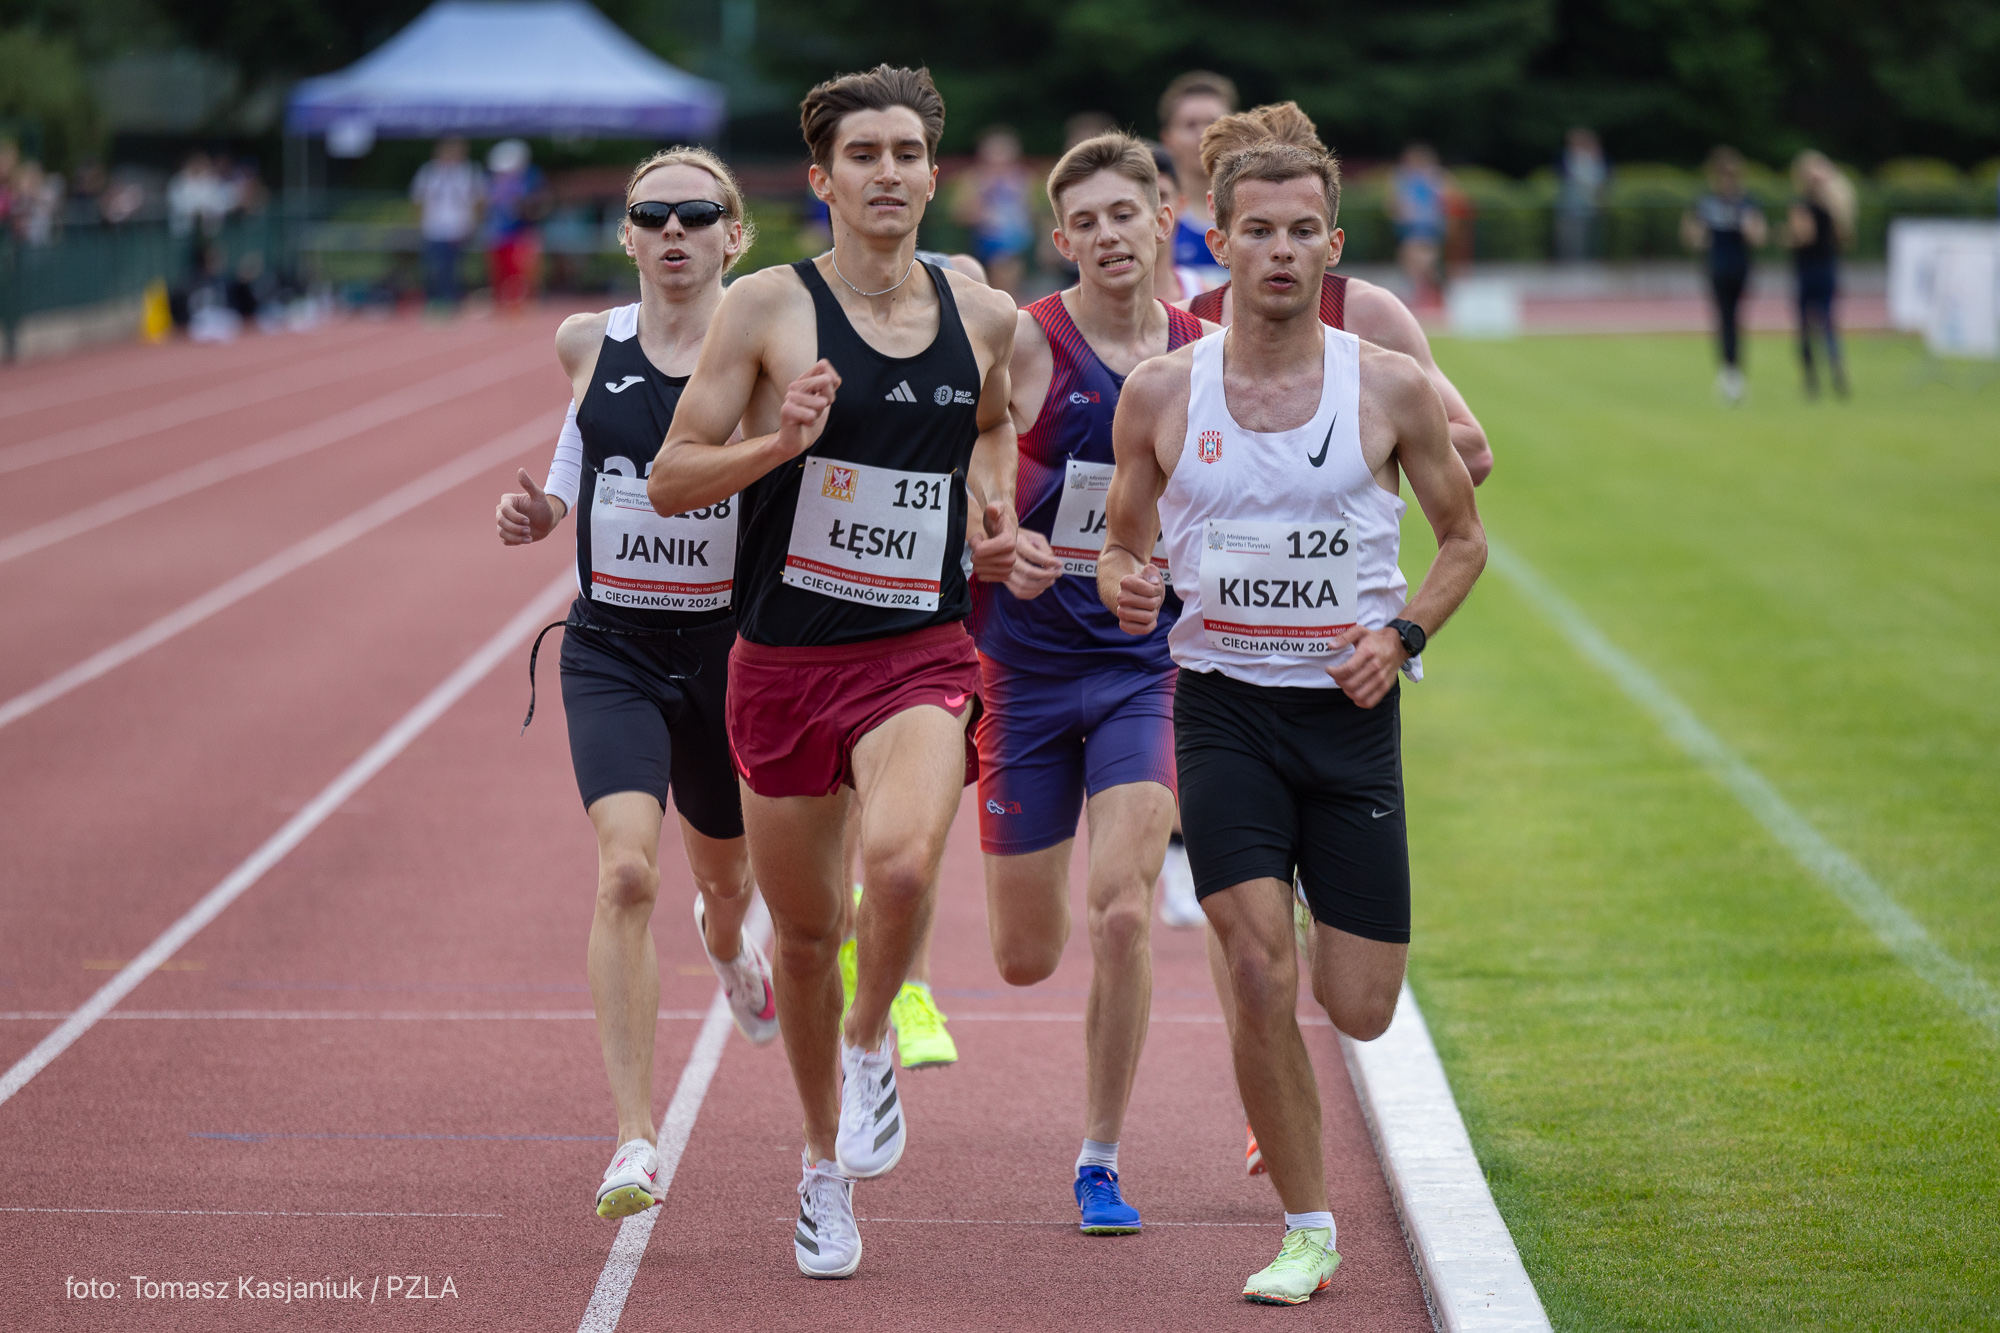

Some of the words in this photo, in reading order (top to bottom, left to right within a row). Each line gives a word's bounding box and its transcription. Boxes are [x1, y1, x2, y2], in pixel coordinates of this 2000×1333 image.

[892, 479, 942, 510] 131
[616, 533, 709, 567] JANIK
[828, 519, 917, 560] ŁĘSKI
[1226, 534, 1260, 542] Ministerstwo
[1286, 528, 1349, 560] 126
[802, 575, 889, 603] CIECHANÓW
[891, 594, 920, 606] 2024
[841, 571, 859, 581] Polski
[605, 590, 685, 608] CIECHANÓW
[687, 597, 718, 608] 2024
[1219, 577, 1339, 609] KISZKA
[1222, 637, 1304, 652] CIECHANÓW
